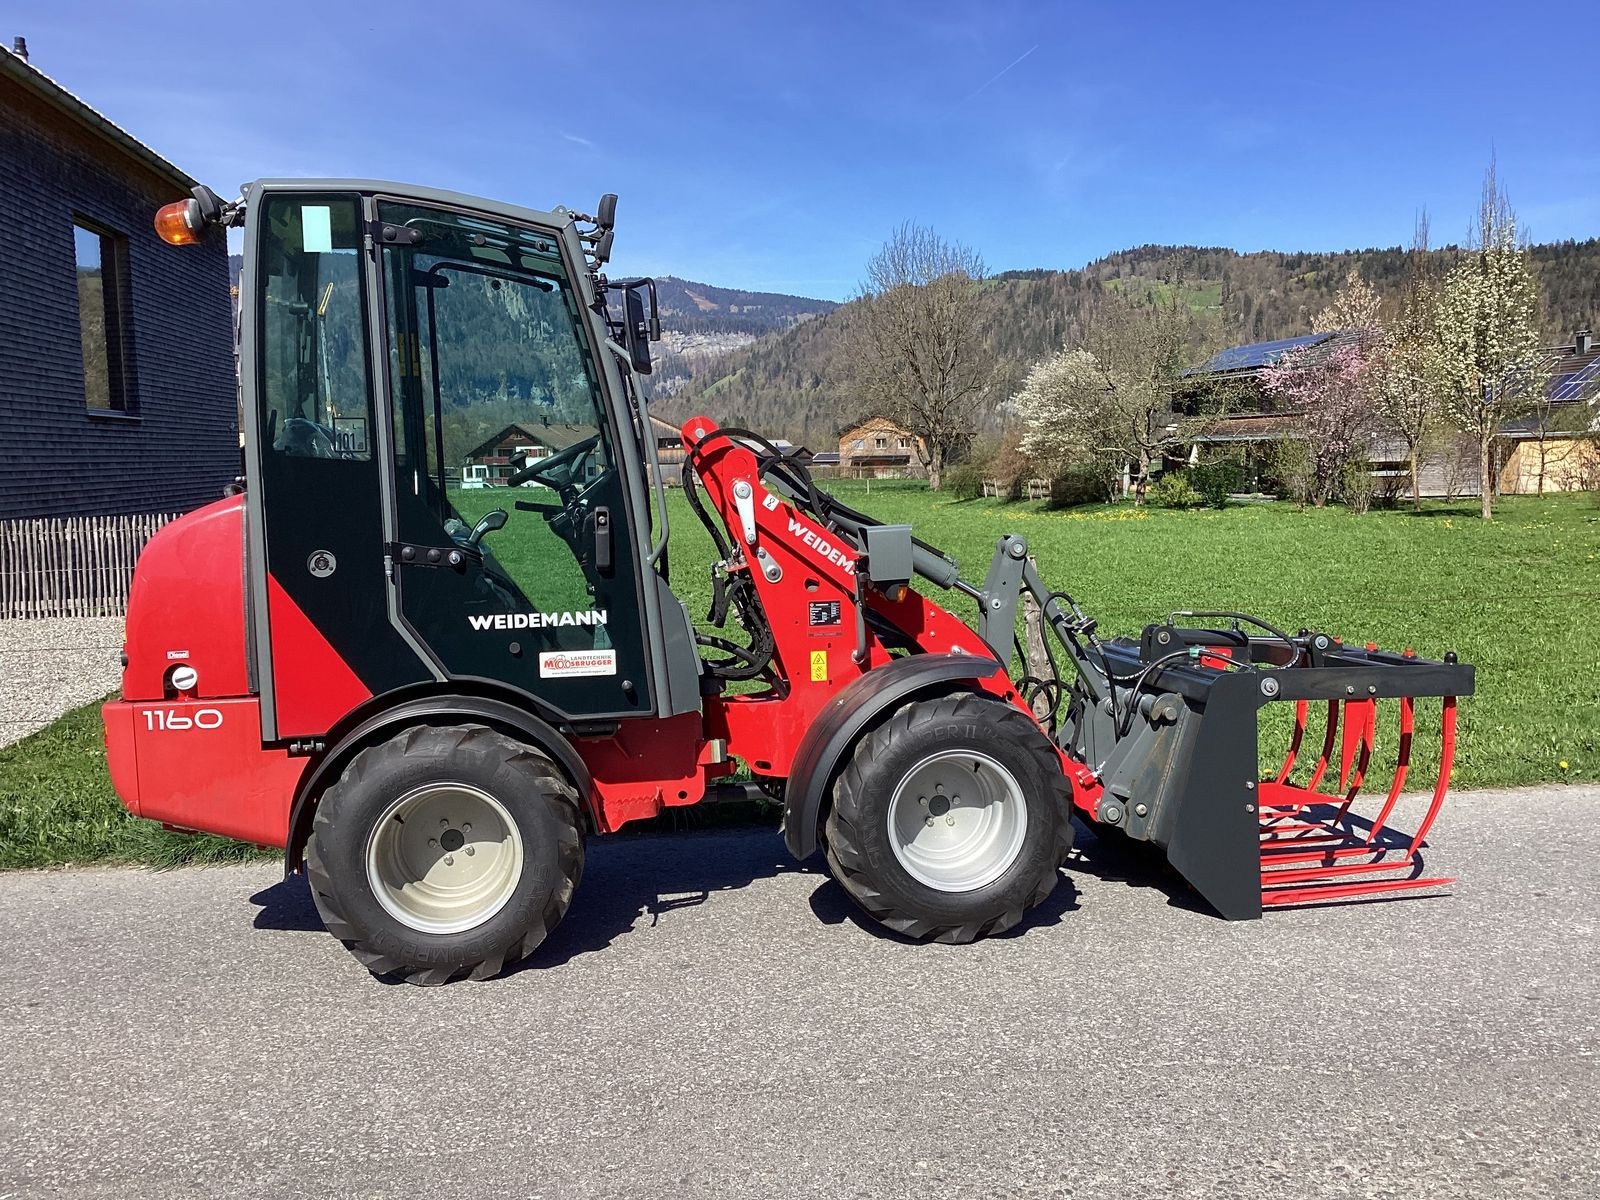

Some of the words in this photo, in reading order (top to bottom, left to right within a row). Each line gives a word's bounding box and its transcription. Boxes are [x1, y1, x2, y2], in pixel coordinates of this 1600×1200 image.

[337, 433, 355, 449] 101
[467, 610, 608, 631] WEIDEMANN
[543, 658, 613, 670] MOOSBRUGGER
[142, 709, 224, 731] 1160
